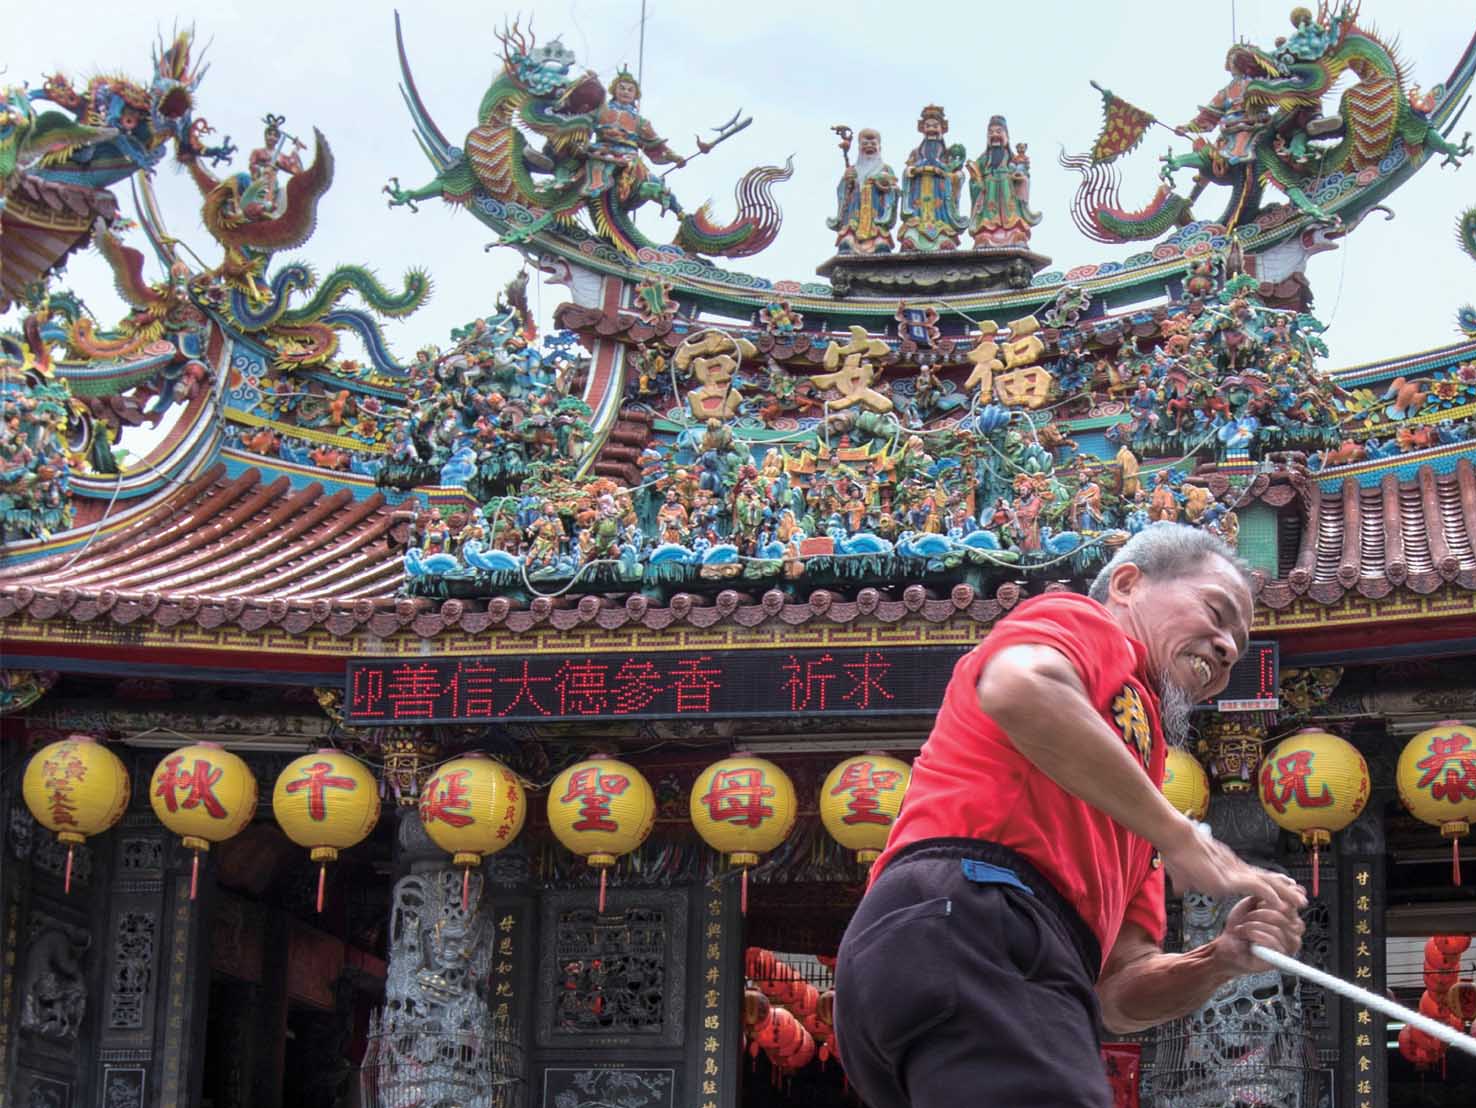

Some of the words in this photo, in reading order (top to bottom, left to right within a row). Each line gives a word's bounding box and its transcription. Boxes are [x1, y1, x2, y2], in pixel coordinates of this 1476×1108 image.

[675, 313, 1053, 421] 福安宮
[782, 652, 894, 711] 祈求
[155, 755, 228, 820] 秋
[285, 762, 357, 822] 千
[559, 767, 631, 832] 聖
[700, 768, 776, 829] 母
[830, 761, 902, 826] 聖
[1261, 750, 1335, 814] 祝
